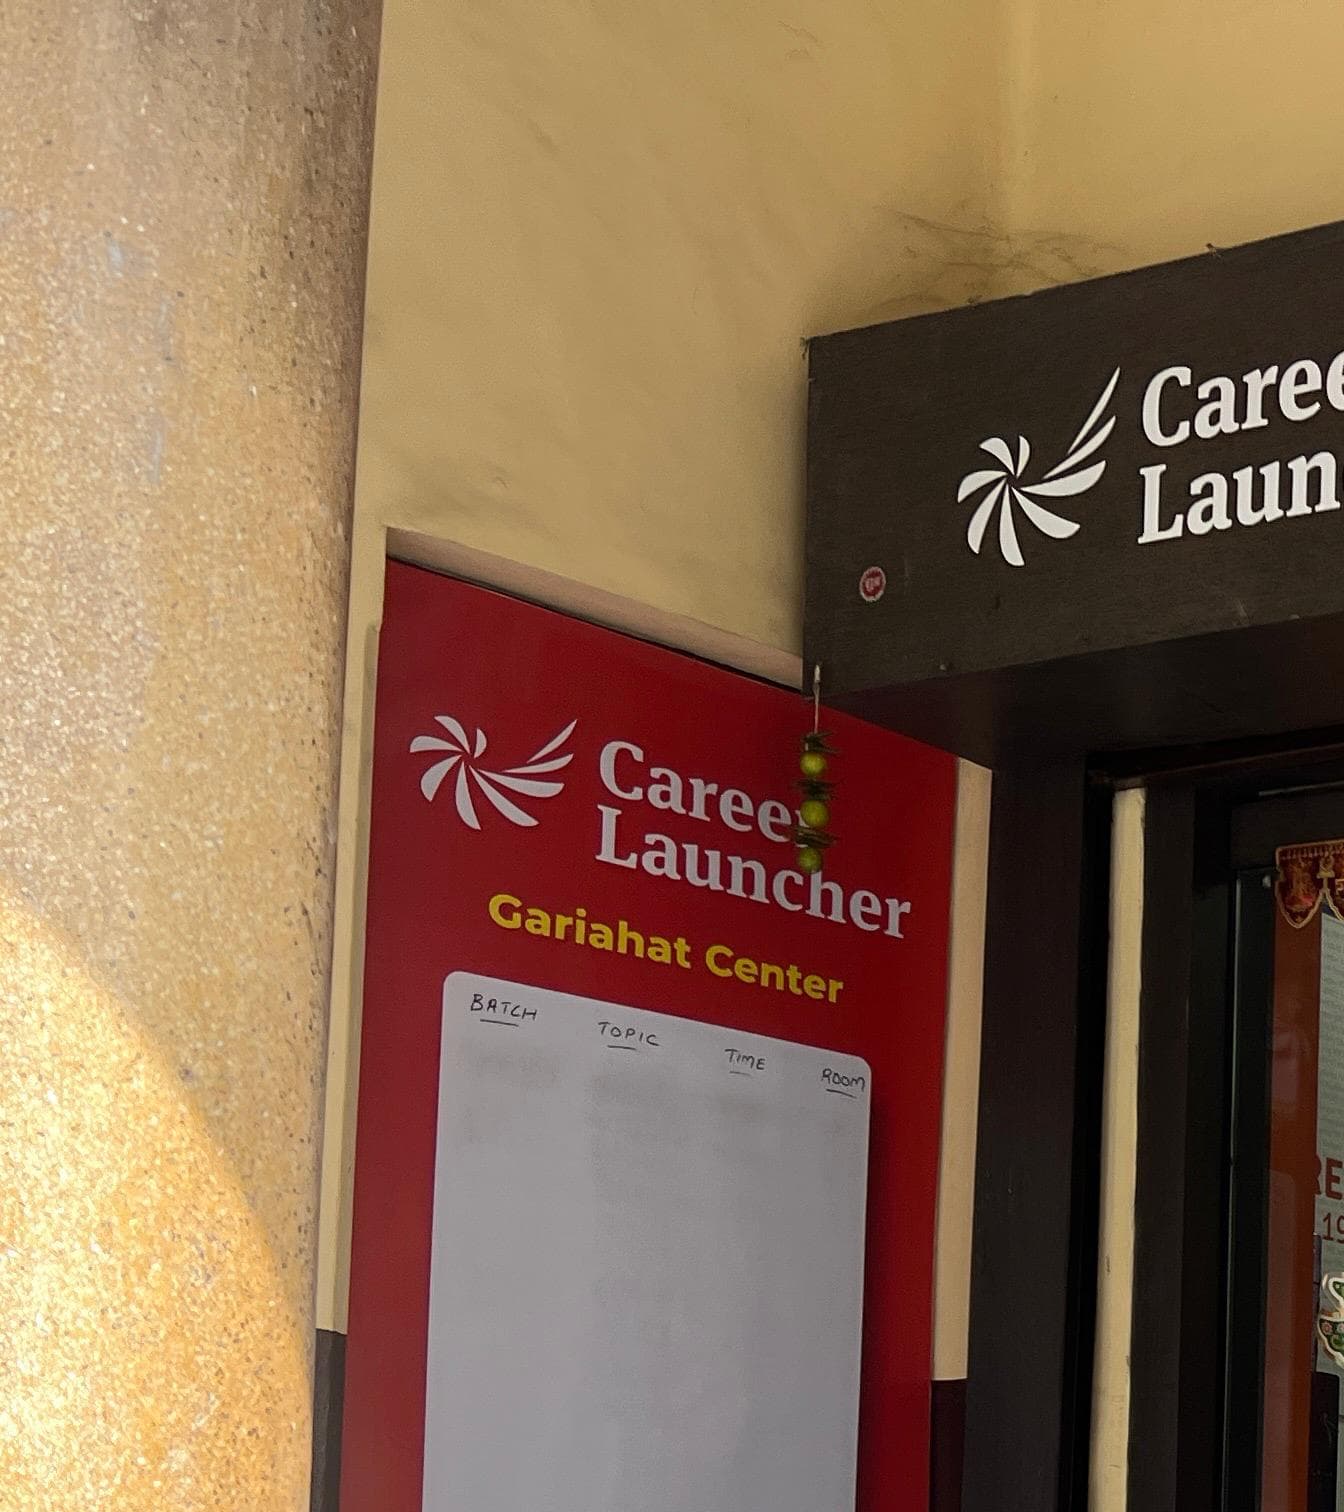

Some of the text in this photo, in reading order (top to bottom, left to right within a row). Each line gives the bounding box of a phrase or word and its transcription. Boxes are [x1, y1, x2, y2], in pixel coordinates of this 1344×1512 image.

[595, 804, 911, 938] Launcher
[488, 894, 843, 1003] Gariahat Center
[470, 993, 866, 1092] BATCH TOPIC TIME ROOM
